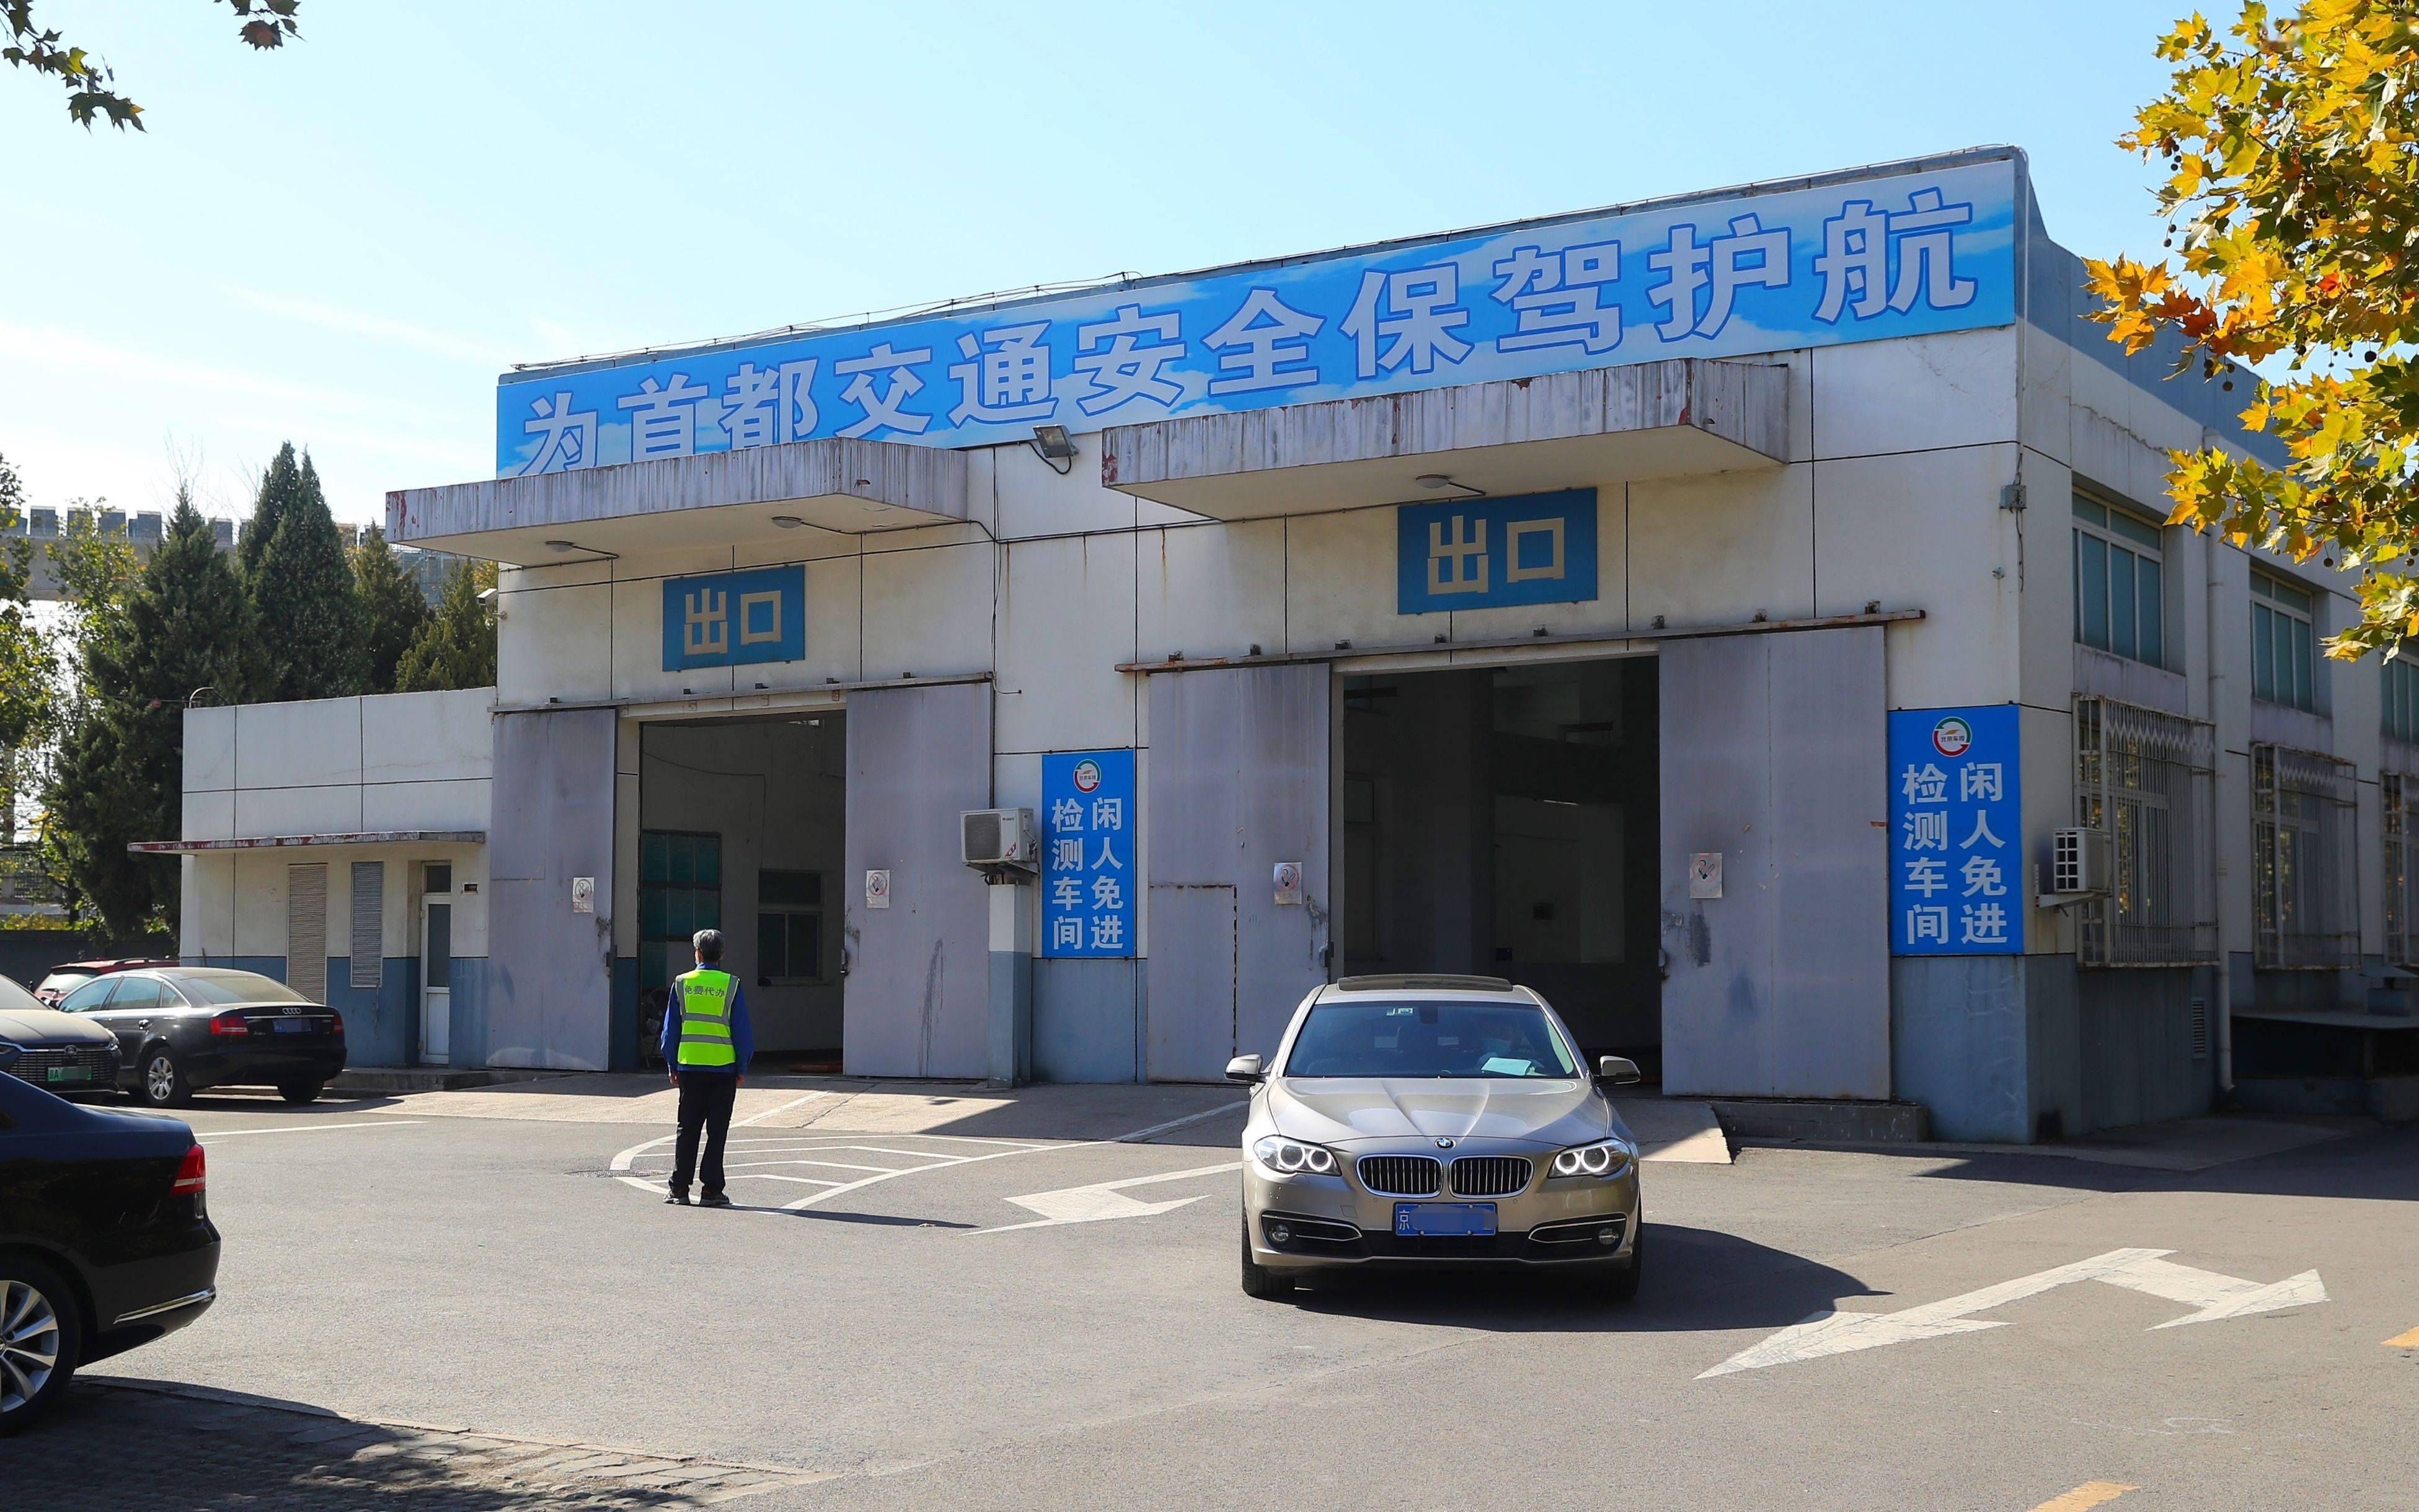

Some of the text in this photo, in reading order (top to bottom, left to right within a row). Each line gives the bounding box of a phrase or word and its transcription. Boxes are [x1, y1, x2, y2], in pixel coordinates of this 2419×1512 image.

[520, 187, 1978, 475] 为首都交通安全保驾护航
[684, 588, 781, 655] 出口
[1428, 515, 1565, 595] 出口
[1052, 798, 1084, 950] 检测车间
[1091, 797, 1124, 949] 闲人免进
[1902, 763, 1948, 945] 检测车间
[1959, 761, 2008, 944] 闲人免进
[684, 985, 725, 997] 免费代办
